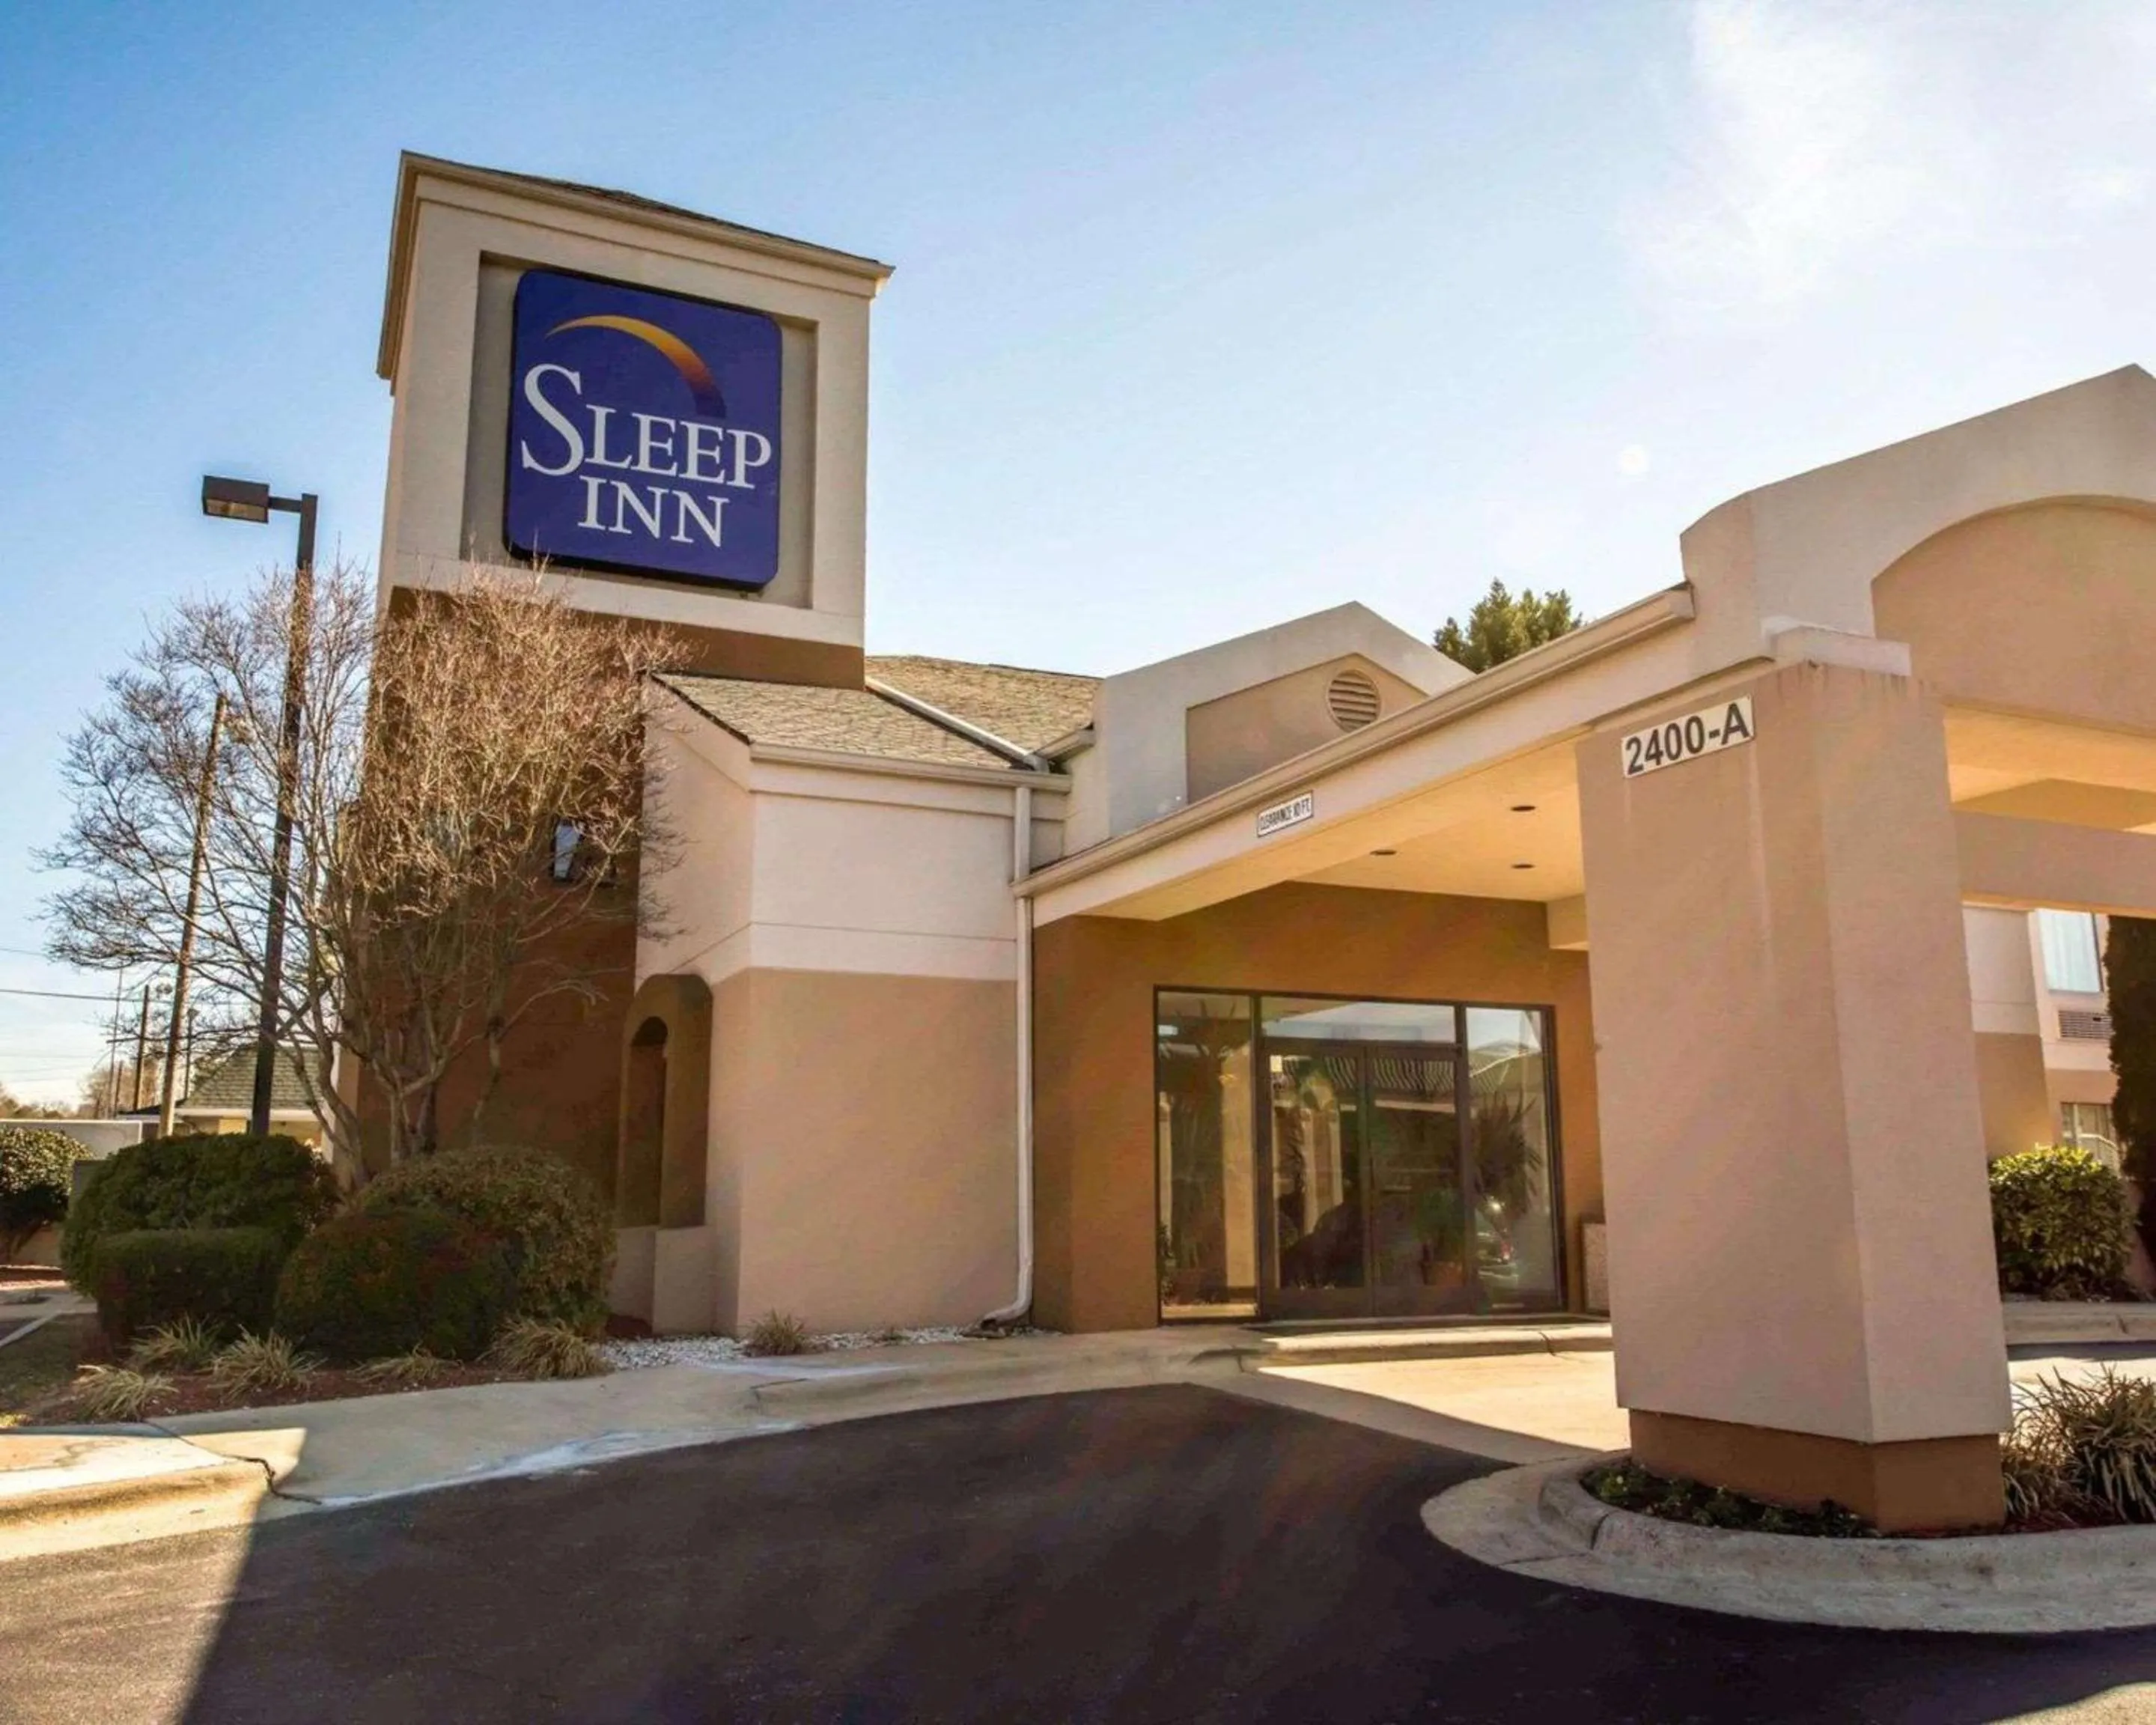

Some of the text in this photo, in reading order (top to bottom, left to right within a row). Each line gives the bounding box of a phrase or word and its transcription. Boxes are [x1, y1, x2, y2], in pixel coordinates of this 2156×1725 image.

[522, 363, 772, 489] SLEEP
[578, 475, 730, 548] INN
[1626, 702, 1750, 775] 2400-A
